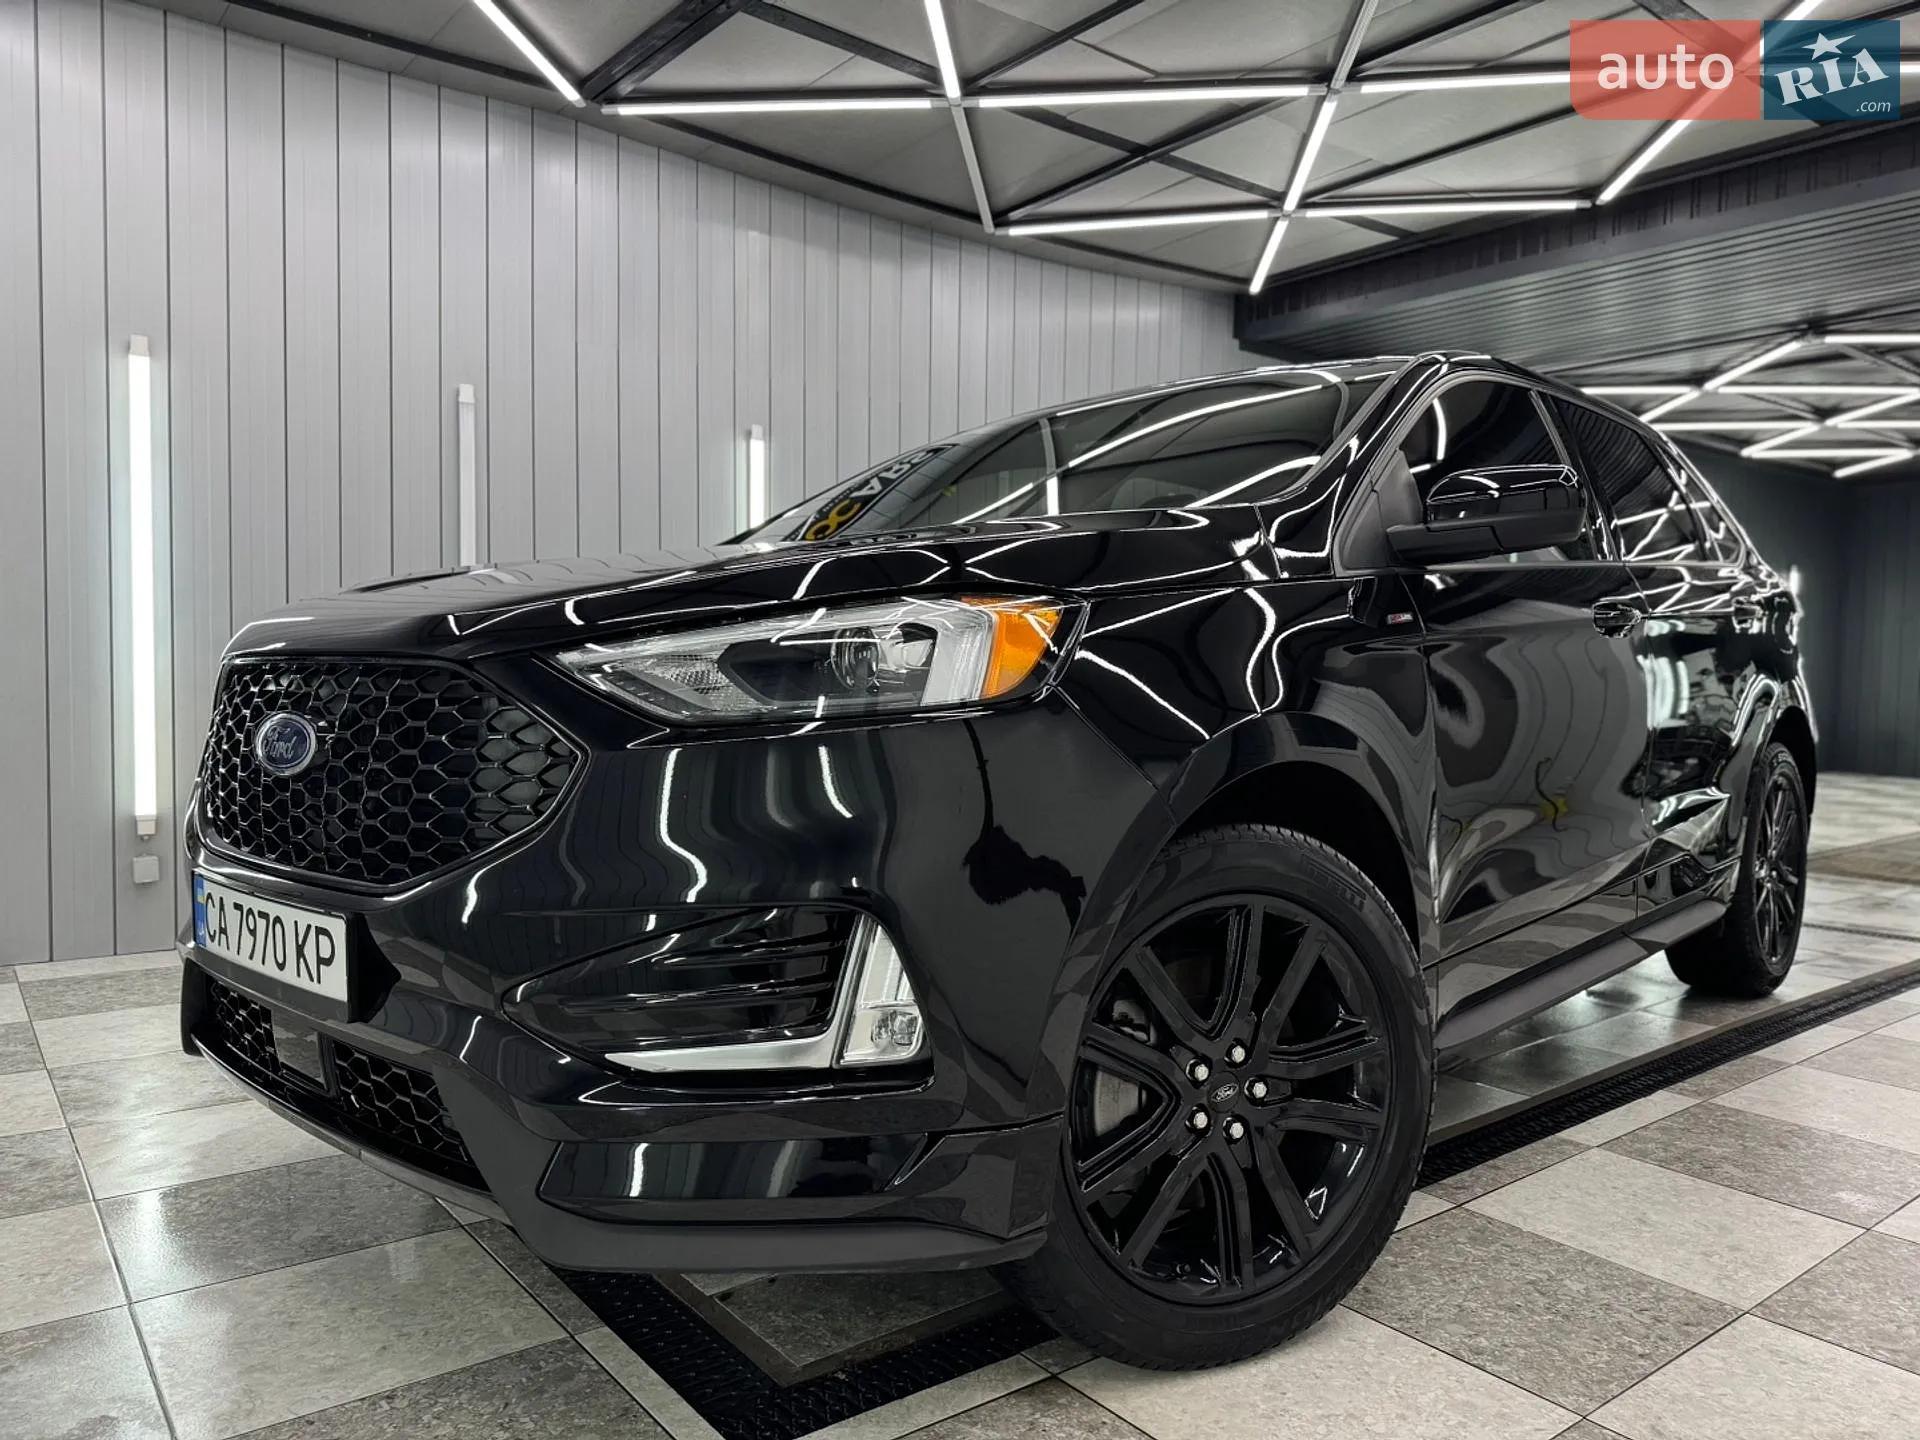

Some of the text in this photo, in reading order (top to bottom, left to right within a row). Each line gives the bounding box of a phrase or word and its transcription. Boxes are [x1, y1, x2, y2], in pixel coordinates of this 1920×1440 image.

[263, 725, 298, 760] Ford
[205, 891, 336, 985] CA 7970 KP
